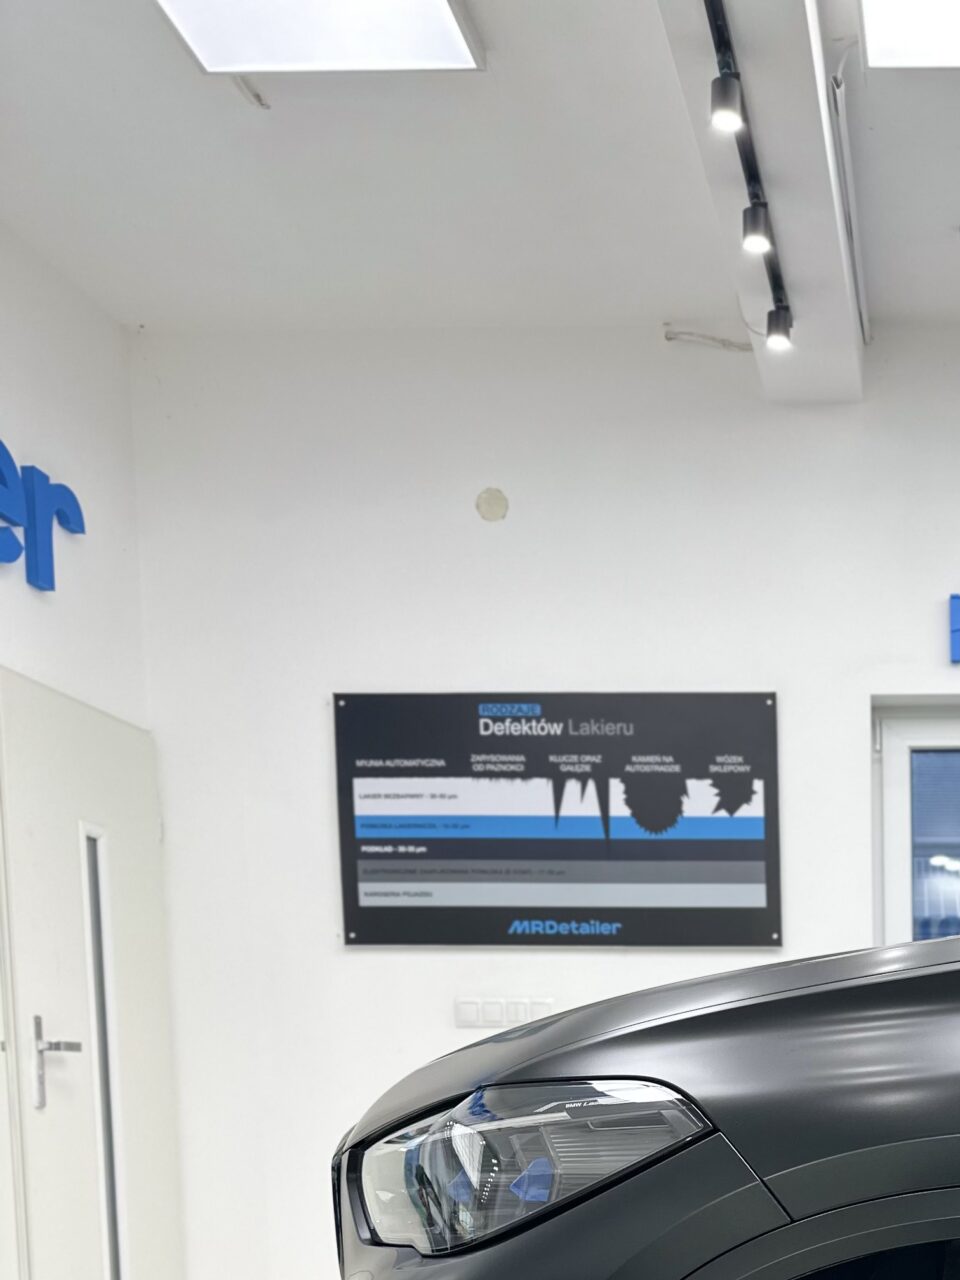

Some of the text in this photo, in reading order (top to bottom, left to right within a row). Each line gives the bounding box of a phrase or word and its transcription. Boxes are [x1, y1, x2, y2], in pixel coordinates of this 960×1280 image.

[480, 704, 539, 716] RODZAJE
[479, 718, 634, 736] Defektów Lakieru
[549, 755, 602, 764] KLUCZE ORAZ
[662, 755, 674, 763] NA
[472, 763, 484, 772] OD
[709, 764, 751, 773] SKLEPOWY
[508, 919, 622, 935] MRDetailer
